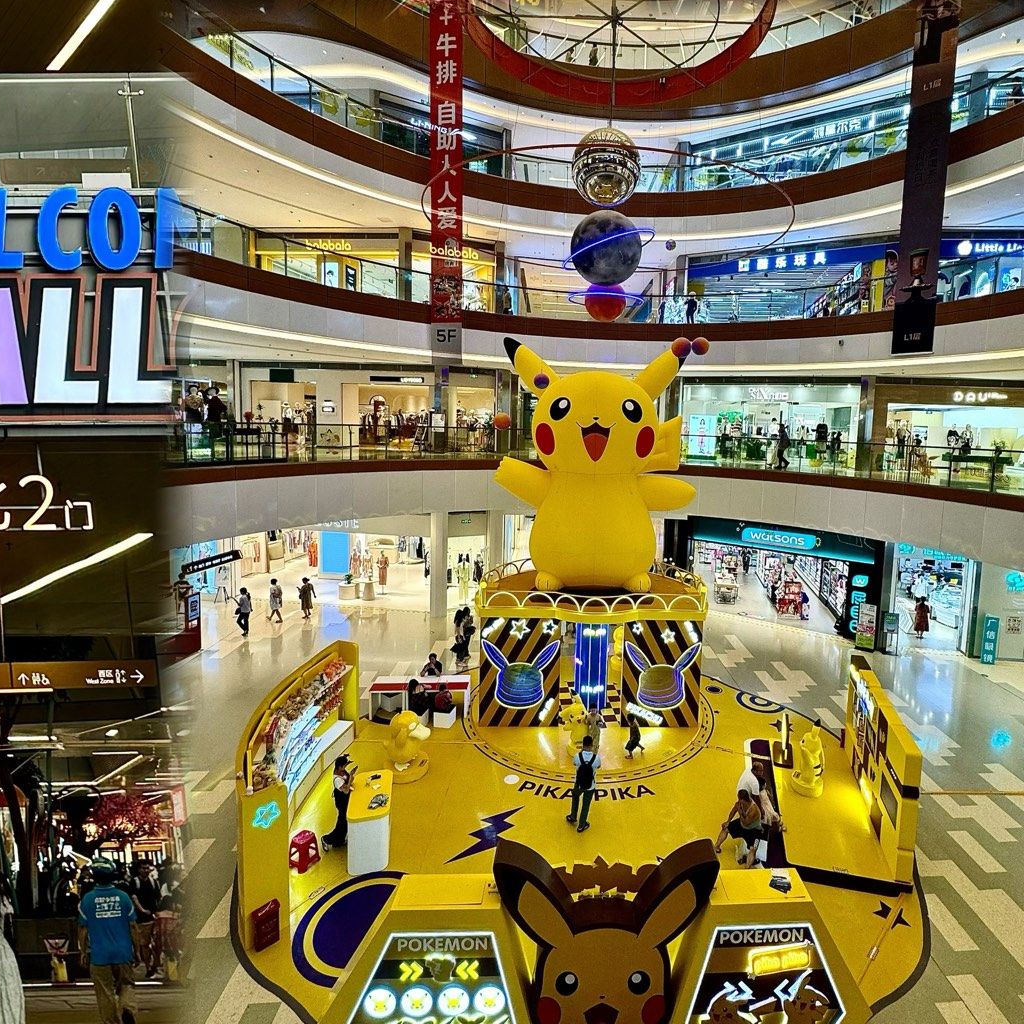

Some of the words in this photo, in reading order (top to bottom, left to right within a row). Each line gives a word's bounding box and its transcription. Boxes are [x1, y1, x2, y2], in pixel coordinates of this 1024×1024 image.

[410, 117, 448, 134] LI-NING
[437, 101, 457, 229] 自助人人爱
[306, 240, 351, 251] balabala
[429, 242, 480, 260] balabala
[436, 329, 457, 343] 5F
[750, 531, 806, 546] watsons
[518, 780, 577, 800] PIKA
[594, 784, 655, 802] PIKA
[397, 937, 488, 953] POKEMON
[719, 929, 804, 945] POKEMON
